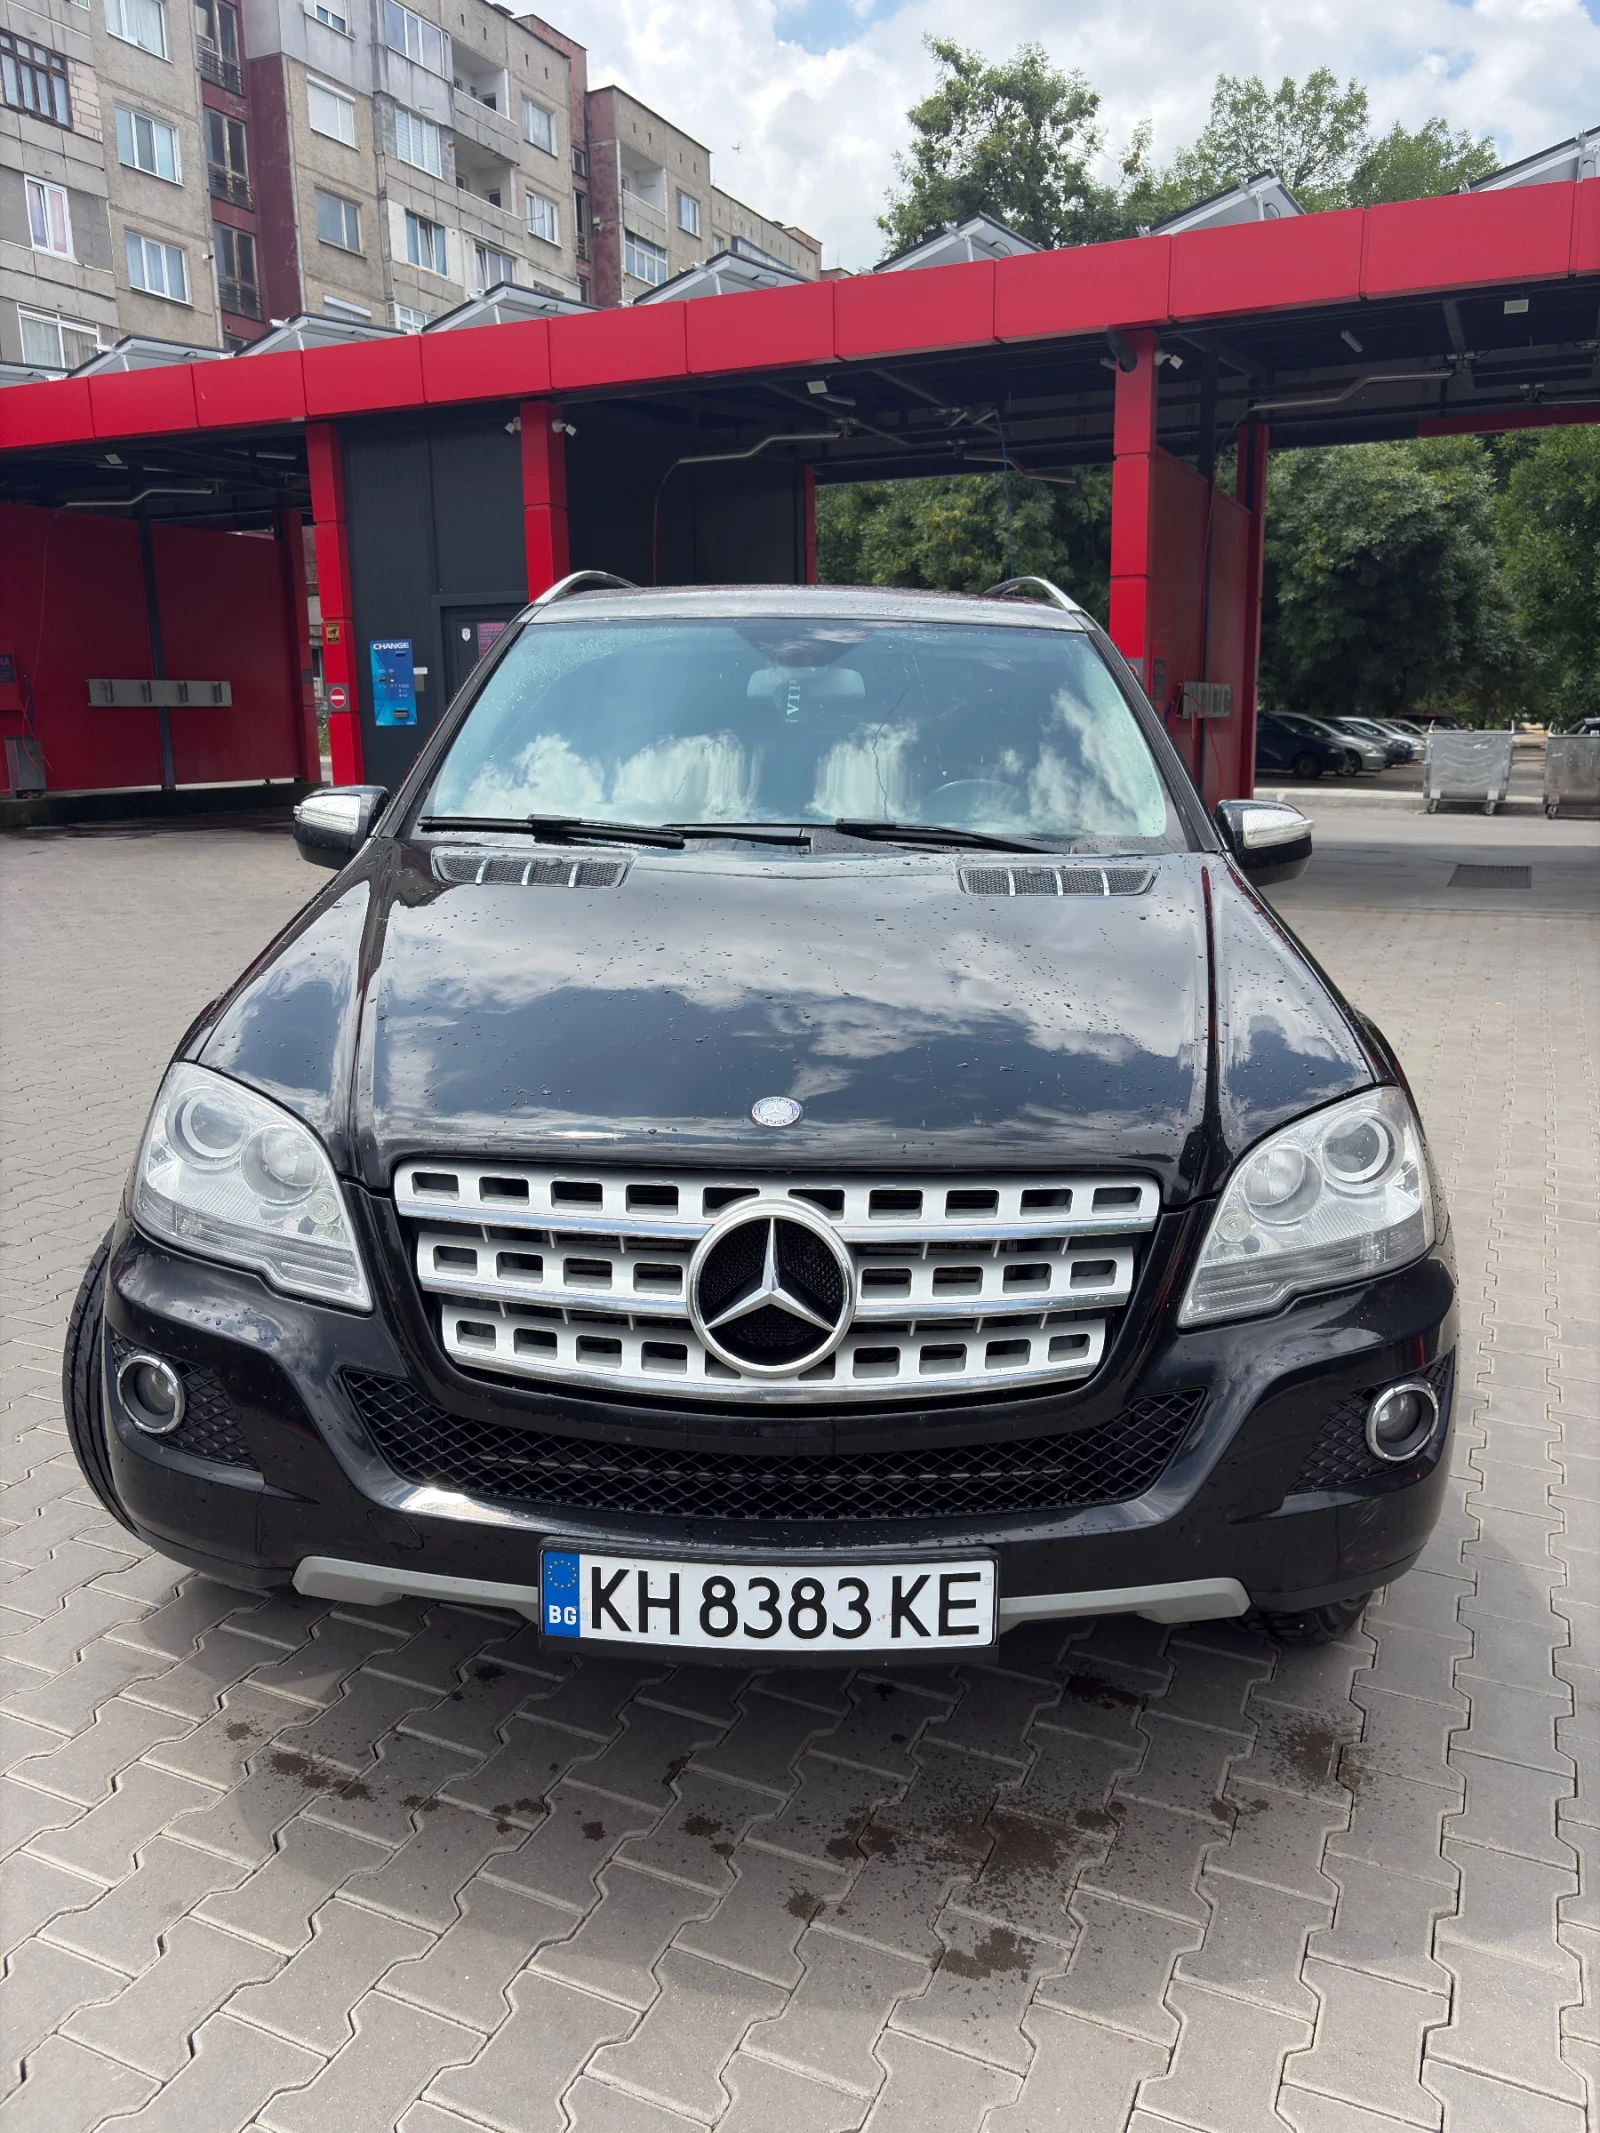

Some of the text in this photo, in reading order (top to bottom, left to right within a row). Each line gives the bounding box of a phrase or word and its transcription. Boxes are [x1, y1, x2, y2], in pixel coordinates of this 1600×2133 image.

[373, 642, 409, 650] CHANGE
[591, 1566, 982, 1639] KH 8383 KE
[549, 1605, 577, 1625] BG
